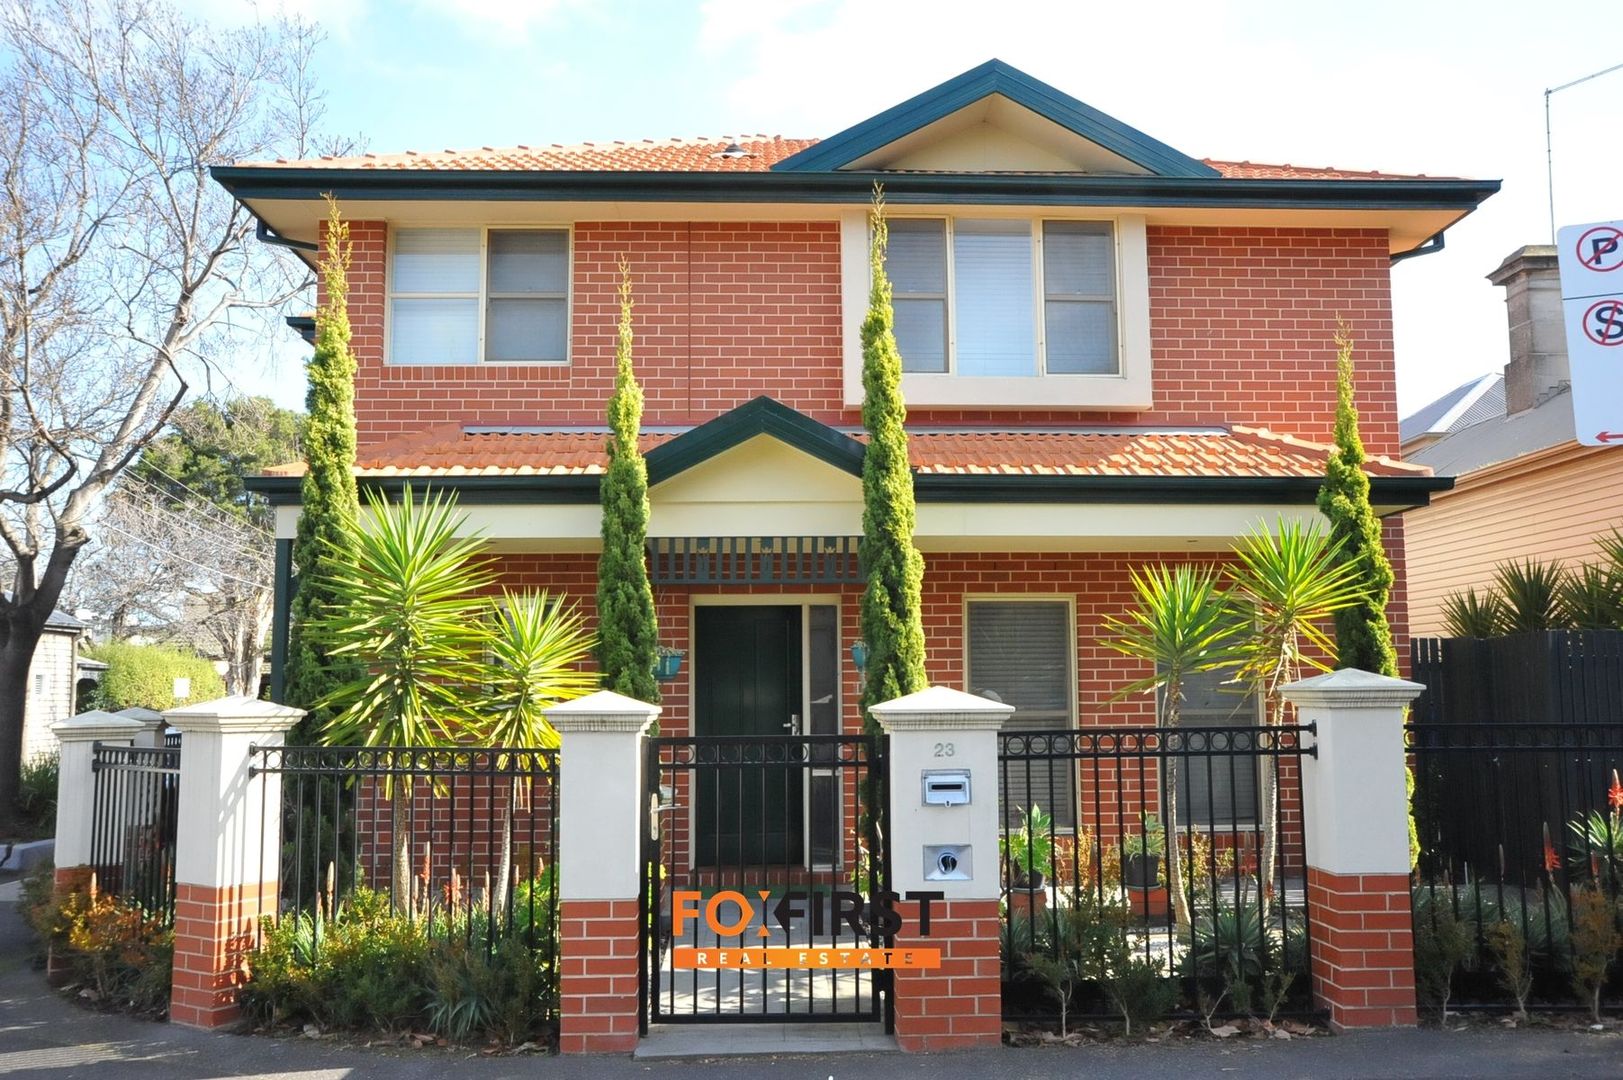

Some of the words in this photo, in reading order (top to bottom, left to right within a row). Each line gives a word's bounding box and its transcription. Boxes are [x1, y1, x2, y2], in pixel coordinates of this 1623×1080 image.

[1592, 237, 1618, 264] P
[1595, 306, 1623, 338] S
[934, 743, 955, 757] 23
